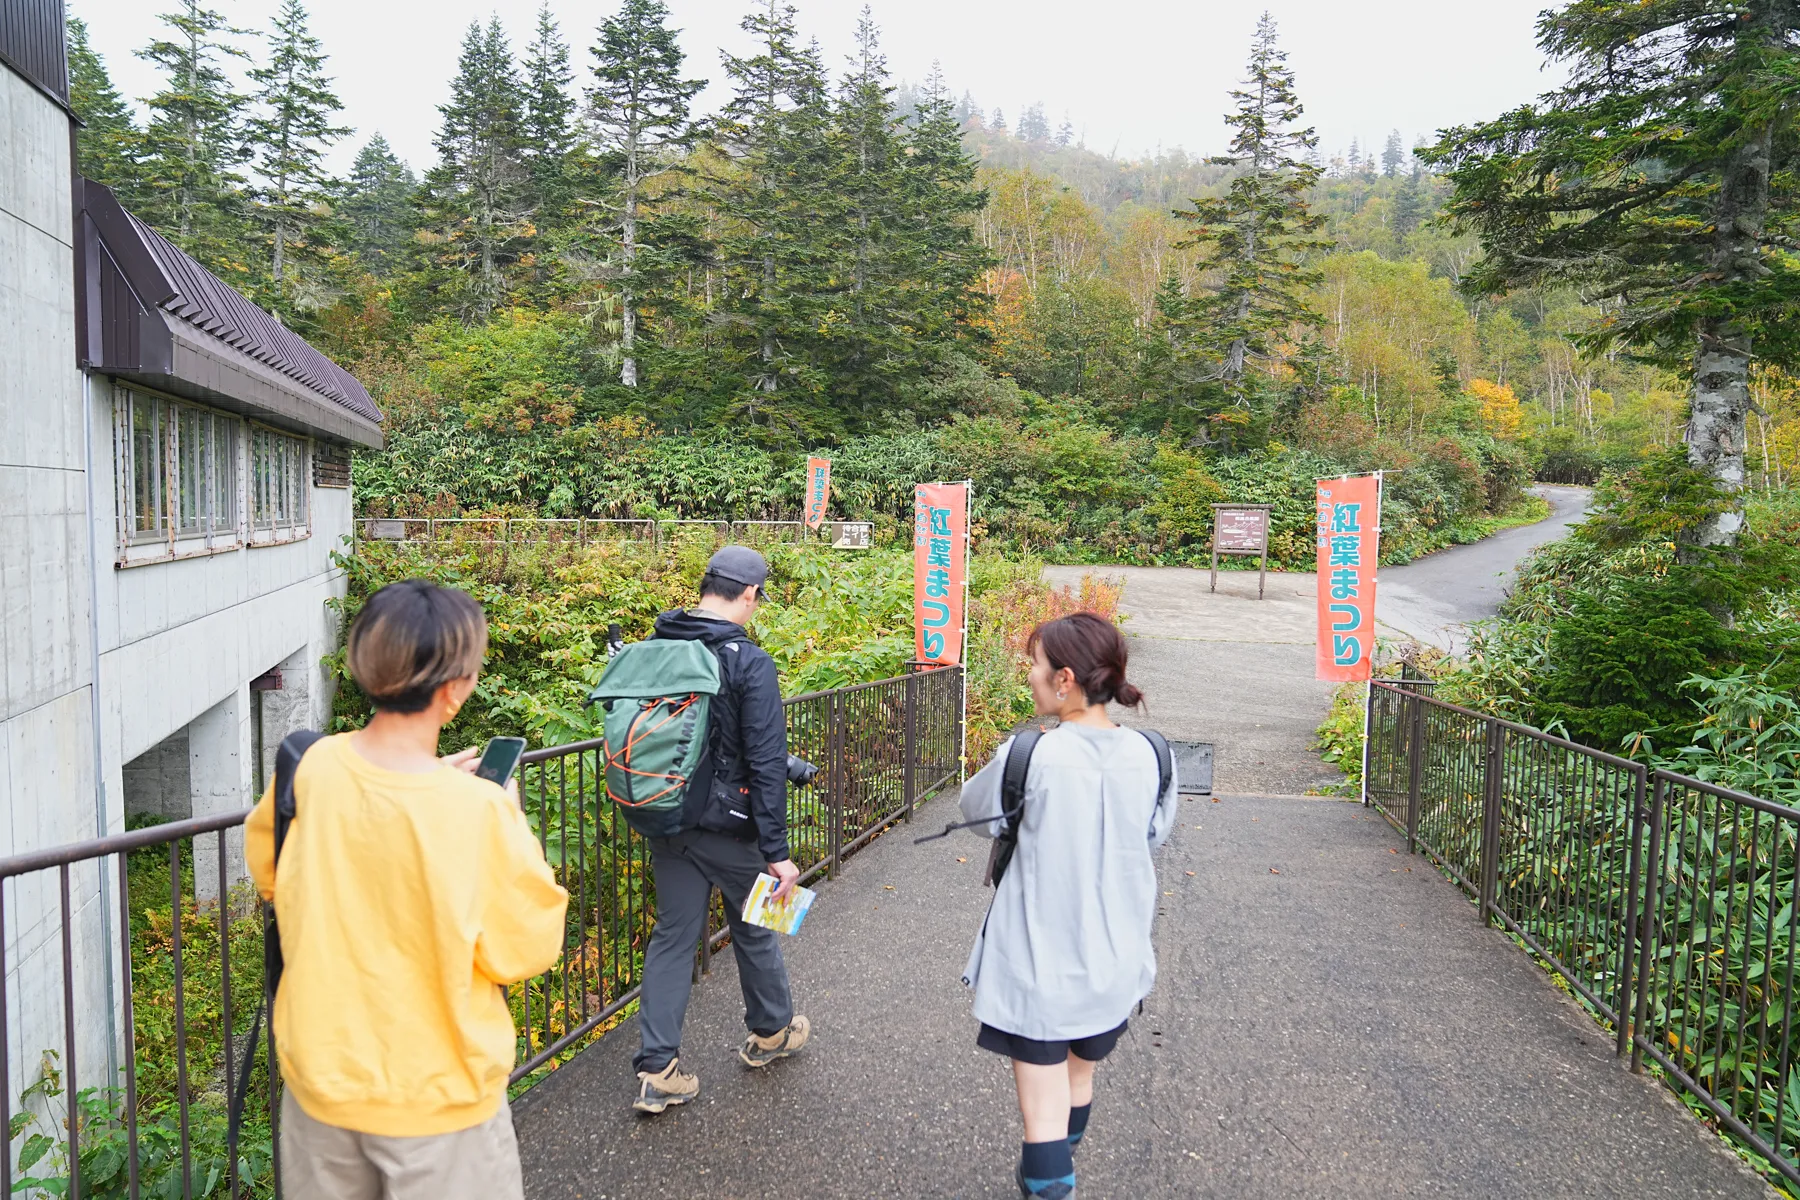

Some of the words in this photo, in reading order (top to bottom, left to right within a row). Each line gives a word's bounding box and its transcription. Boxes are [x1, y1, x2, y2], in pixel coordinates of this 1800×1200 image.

[842, 531, 868, 539] トイレ
[922, 506, 952, 660] 紅葉まつり
[1329, 503, 1362, 666] 紅葉まつり
